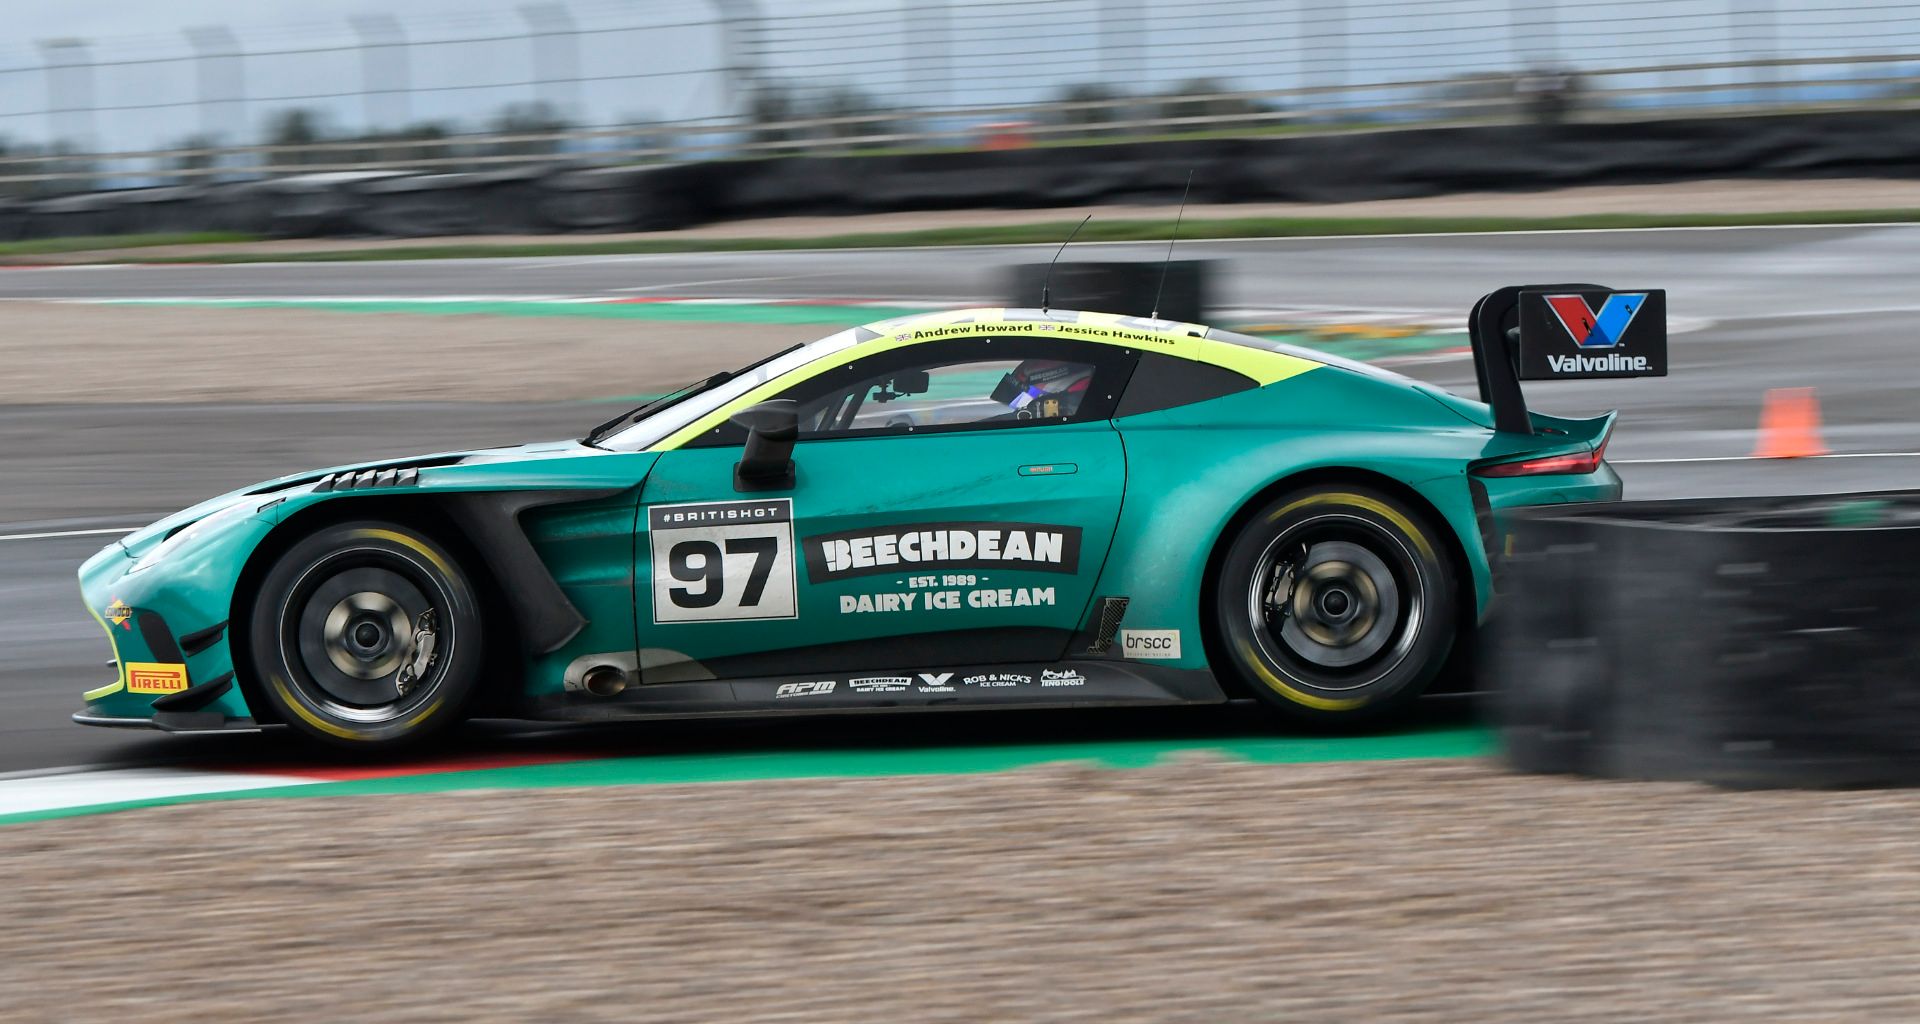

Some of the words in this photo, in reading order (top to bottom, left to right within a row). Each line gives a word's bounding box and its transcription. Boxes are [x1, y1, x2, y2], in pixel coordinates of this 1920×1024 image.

[914, 327, 971, 339] Andrew
[975, 324, 1033, 332] Howard
[1057, 325, 1109, 337] Jessica
[1112, 330, 1176, 345] Hawkins
[1547, 353, 1647, 373] Valvoline
[663, 507, 778, 523] #BRITISHGT
[822, 531, 1062, 571] BEECHDEAN
[669, 537, 777, 608] 97
[909, 576, 939, 589] EST.
[942, 575, 976, 587] 1989
[840, 592, 917, 614] DAIRY
[925, 591, 961, 610] ICE
[967, 587, 1056, 609] CREAM
[1126, 633, 1171, 649] brscc
[131, 670, 182, 690] PIRELLI
[963, 675, 987, 685] ROB
[1000, 674, 1032, 684] NICK'S
